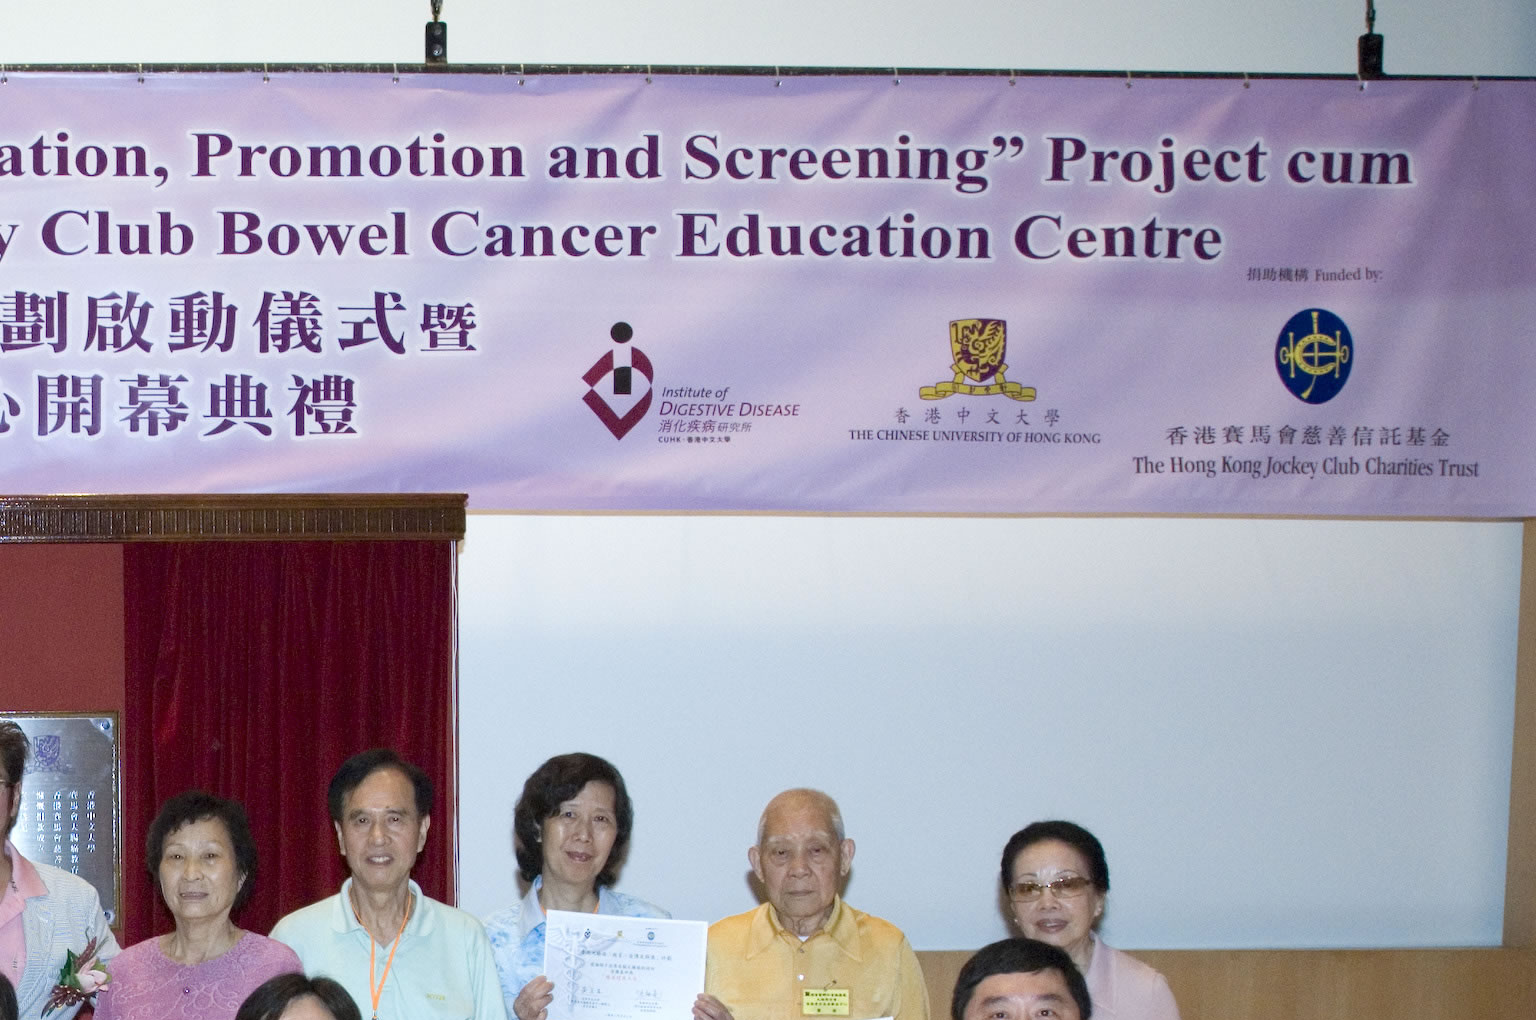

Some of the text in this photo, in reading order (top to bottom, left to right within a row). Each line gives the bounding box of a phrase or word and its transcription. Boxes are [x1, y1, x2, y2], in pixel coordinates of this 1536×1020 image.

[194, 132, 525, 178] Promotion
[548, 134, 661, 179] and
[685, 134, 1024, 194] Screening”
[1049, 137, 1267, 193] Project
[1286, 147, 1414, 185] cum
[41, 210, 194, 256] Club
[220, 211, 408, 256] Bowel
[431, 210, 657, 257] Cancer
[679, 213, 990, 259] Education
[1014, 214, 1222, 261] Centre
[1247, 267, 1383, 283] 捐助機構 Funded by:
[661, 386, 730, 401] Institute of
[659, 400, 800, 417] DIGESTIVE DISEASE
[894, 407, 1061, 427] 香港中文大學
[658, 419, 751, 433] 消化疾病研究所
[849, 429, 1101, 444] THE CHINESE UNIVERSITY OF HONG KONG
[1165, 424, 1452, 447] 香港賽馬會慈善信託基金
[1132, 455, 1479, 480] The Hong Kong Jockey Club Charities Trust
